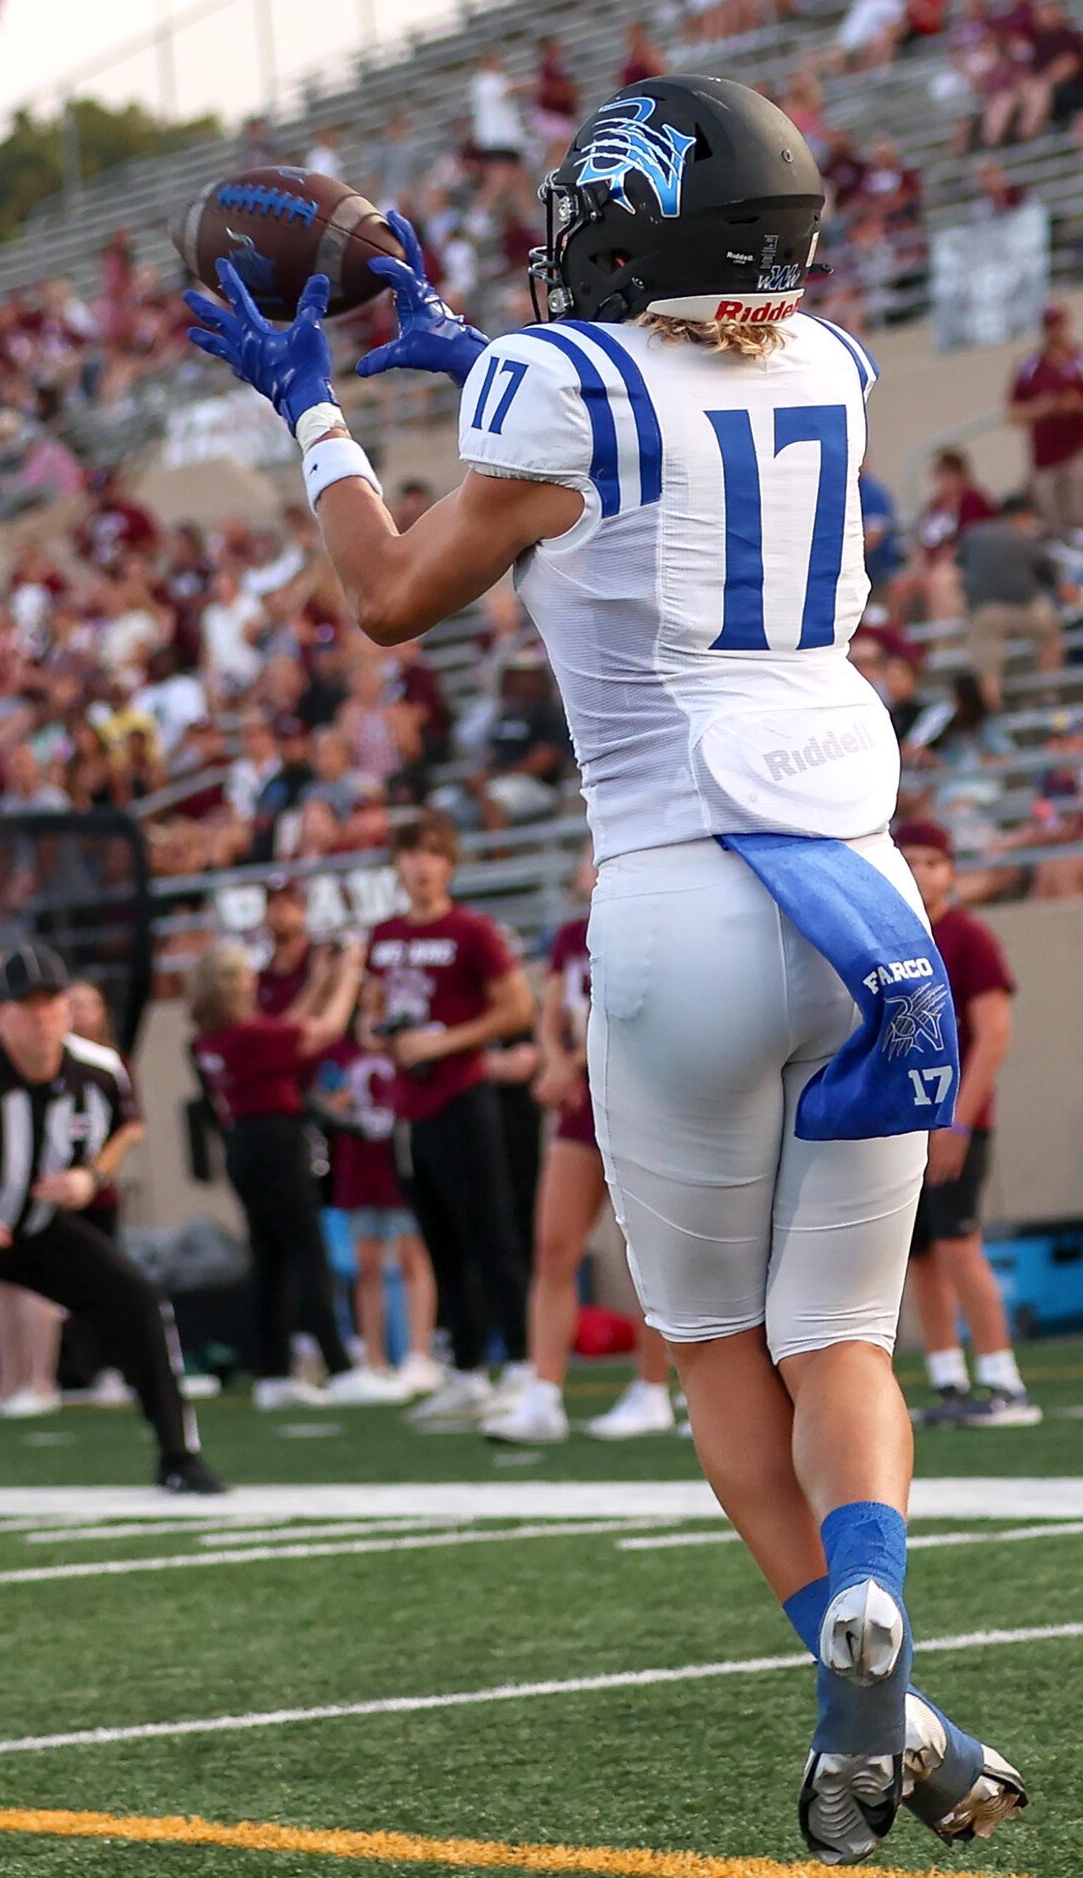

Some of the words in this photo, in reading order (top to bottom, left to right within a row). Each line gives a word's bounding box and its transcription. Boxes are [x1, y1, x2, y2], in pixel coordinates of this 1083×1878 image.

[726, 251, 754, 262] Riddell
[715, 298, 801, 323] Riddel
[471, 356, 529, 435] 17
[703, 404, 848, 651] 17
[762, 721, 876, 781] Riddell
[862, 957, 934, 995] FARCO
[908, 1065, 953, 1106] 17
